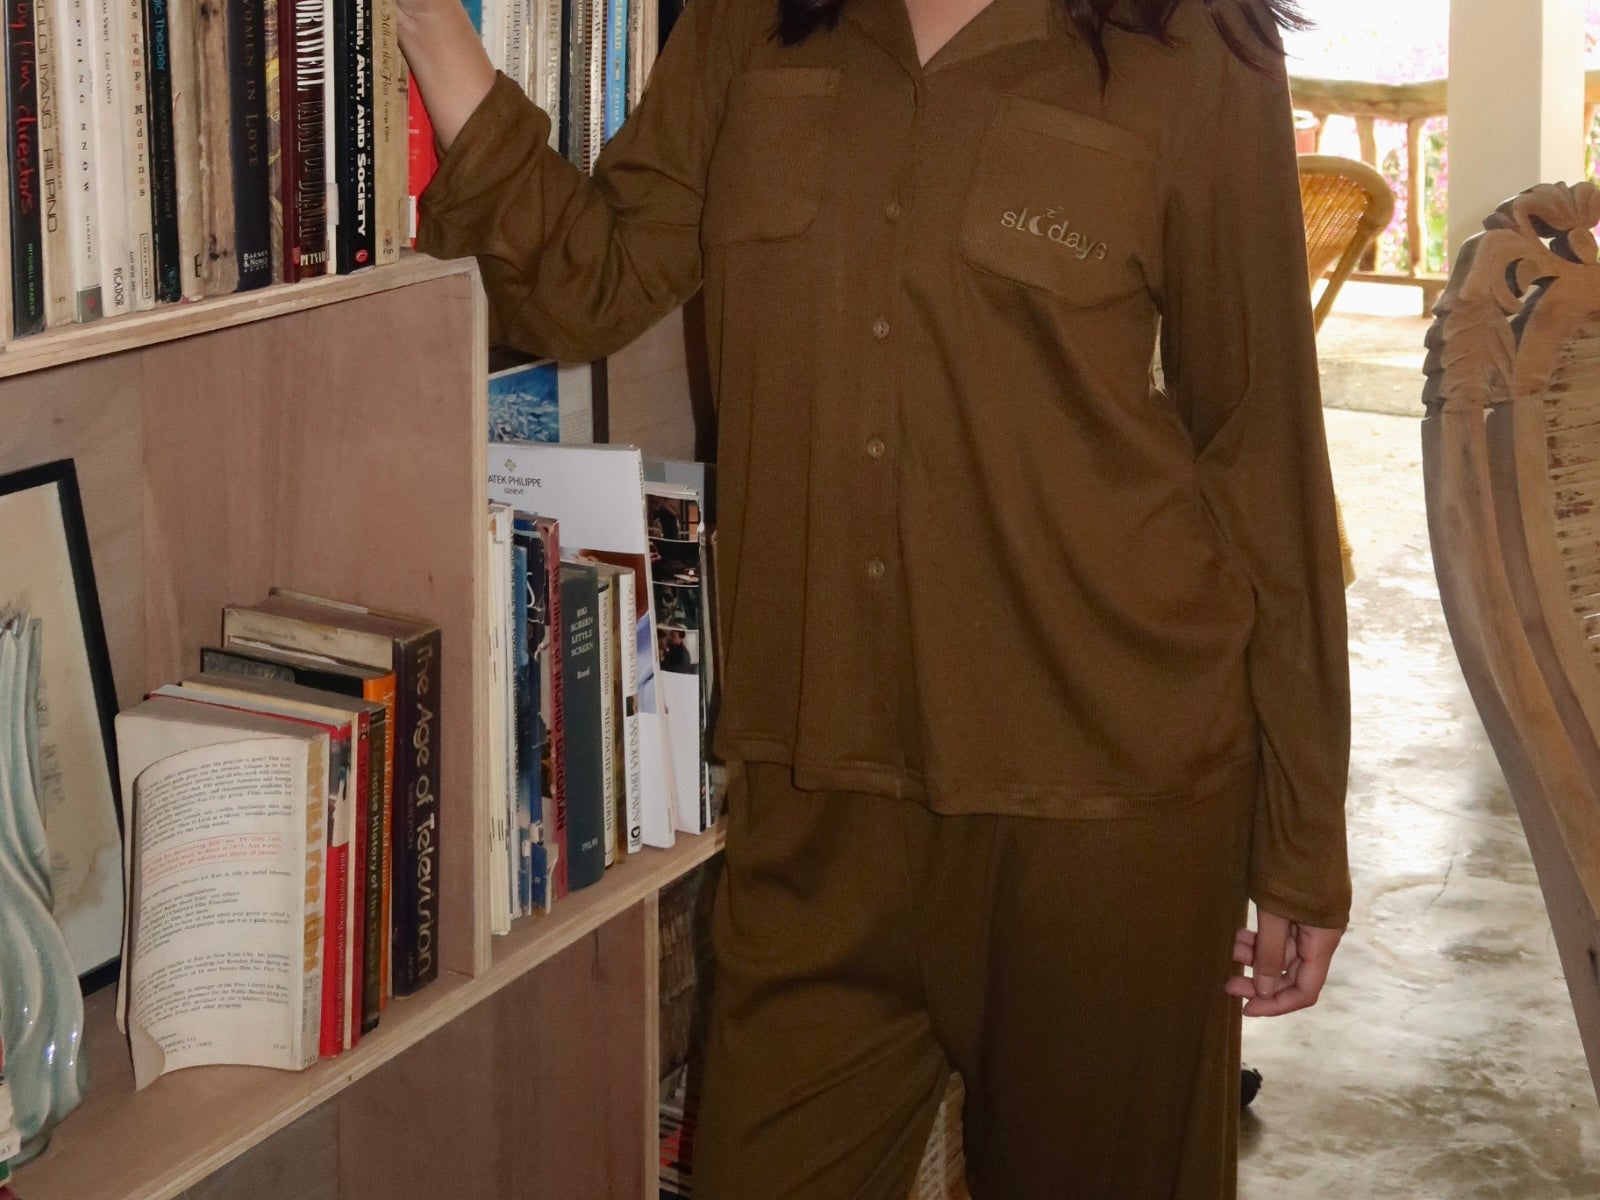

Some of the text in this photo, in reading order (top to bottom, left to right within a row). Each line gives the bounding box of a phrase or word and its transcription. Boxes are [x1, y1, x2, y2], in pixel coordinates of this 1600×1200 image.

[131, 33, 142, 91] Temps
[155, 18, 167, 71] Theater
[105, 73, 114, 105] Orders
[246, 80, 256, 101] IN
[354, 54, 367, 100] ART,
[244, 112, 259, 167] LOVE
[356, 104, 366, 148] AND
[80, 122, 90, 193] SNOW
[134, 104, 146, 198] Modernes
[356, 153, 367, 237] SOCIETY
[243, 250, 268, 261] BARNES
[113, 267, 125, 307] PICADOR
[488, 474, 542, 488] ATEK PHILIPPE
[570, 616, 594, 633] SCREEN
[576, 606, 588, 618] BIG
[570, 640, 594, 657] SCREEN
[571, 629, 593, 645] LITTLE
[553, 671, 564, 733] INGRID
[603, 706, 613, 773] NIETZSCHE
[555, 737, 567, 831] BERGMAN
[629, 716, 641, 822] SANDRA BROWN
[412, 641, 436, 978] The Age of Television
[605, 792, 614, 831] TURIN
[368, 815, 381, 870] History
[369, 874, 380, 890] of
